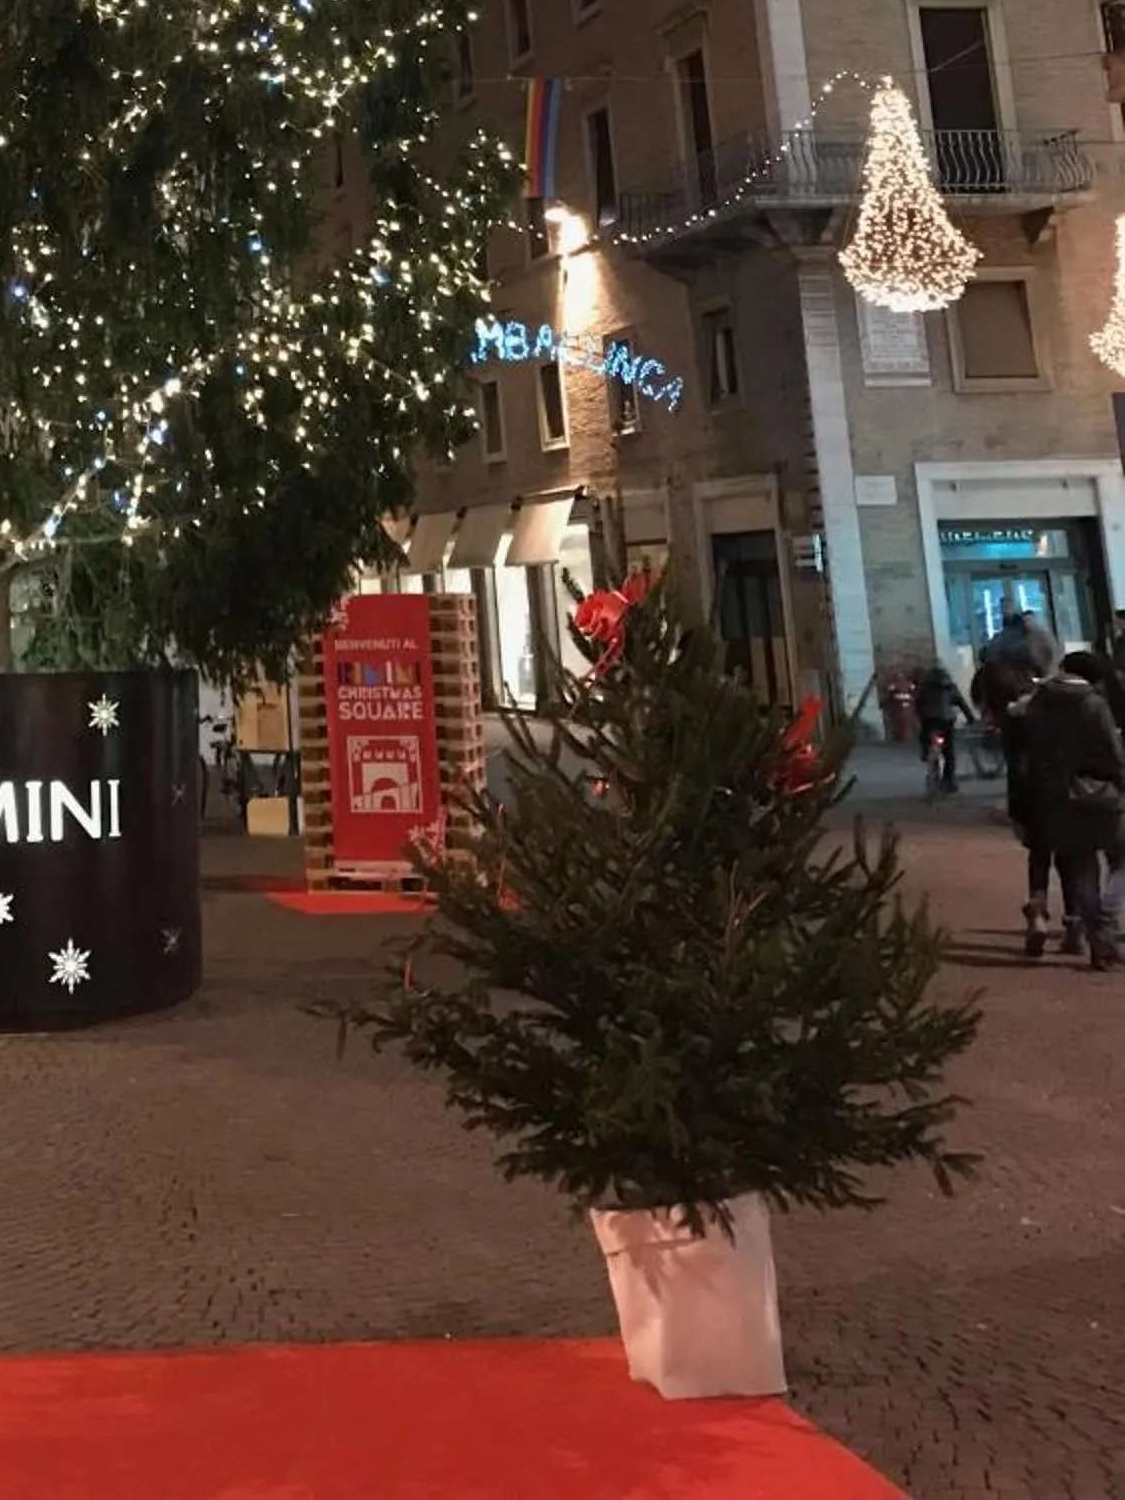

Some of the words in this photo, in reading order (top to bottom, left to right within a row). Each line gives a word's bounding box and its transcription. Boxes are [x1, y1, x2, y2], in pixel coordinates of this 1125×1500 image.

[337, 661, 420, 685] RIMINI
[338, 686, 422, 699] CHRISTMAS
[338, 701, 424, 720] SQUARE
